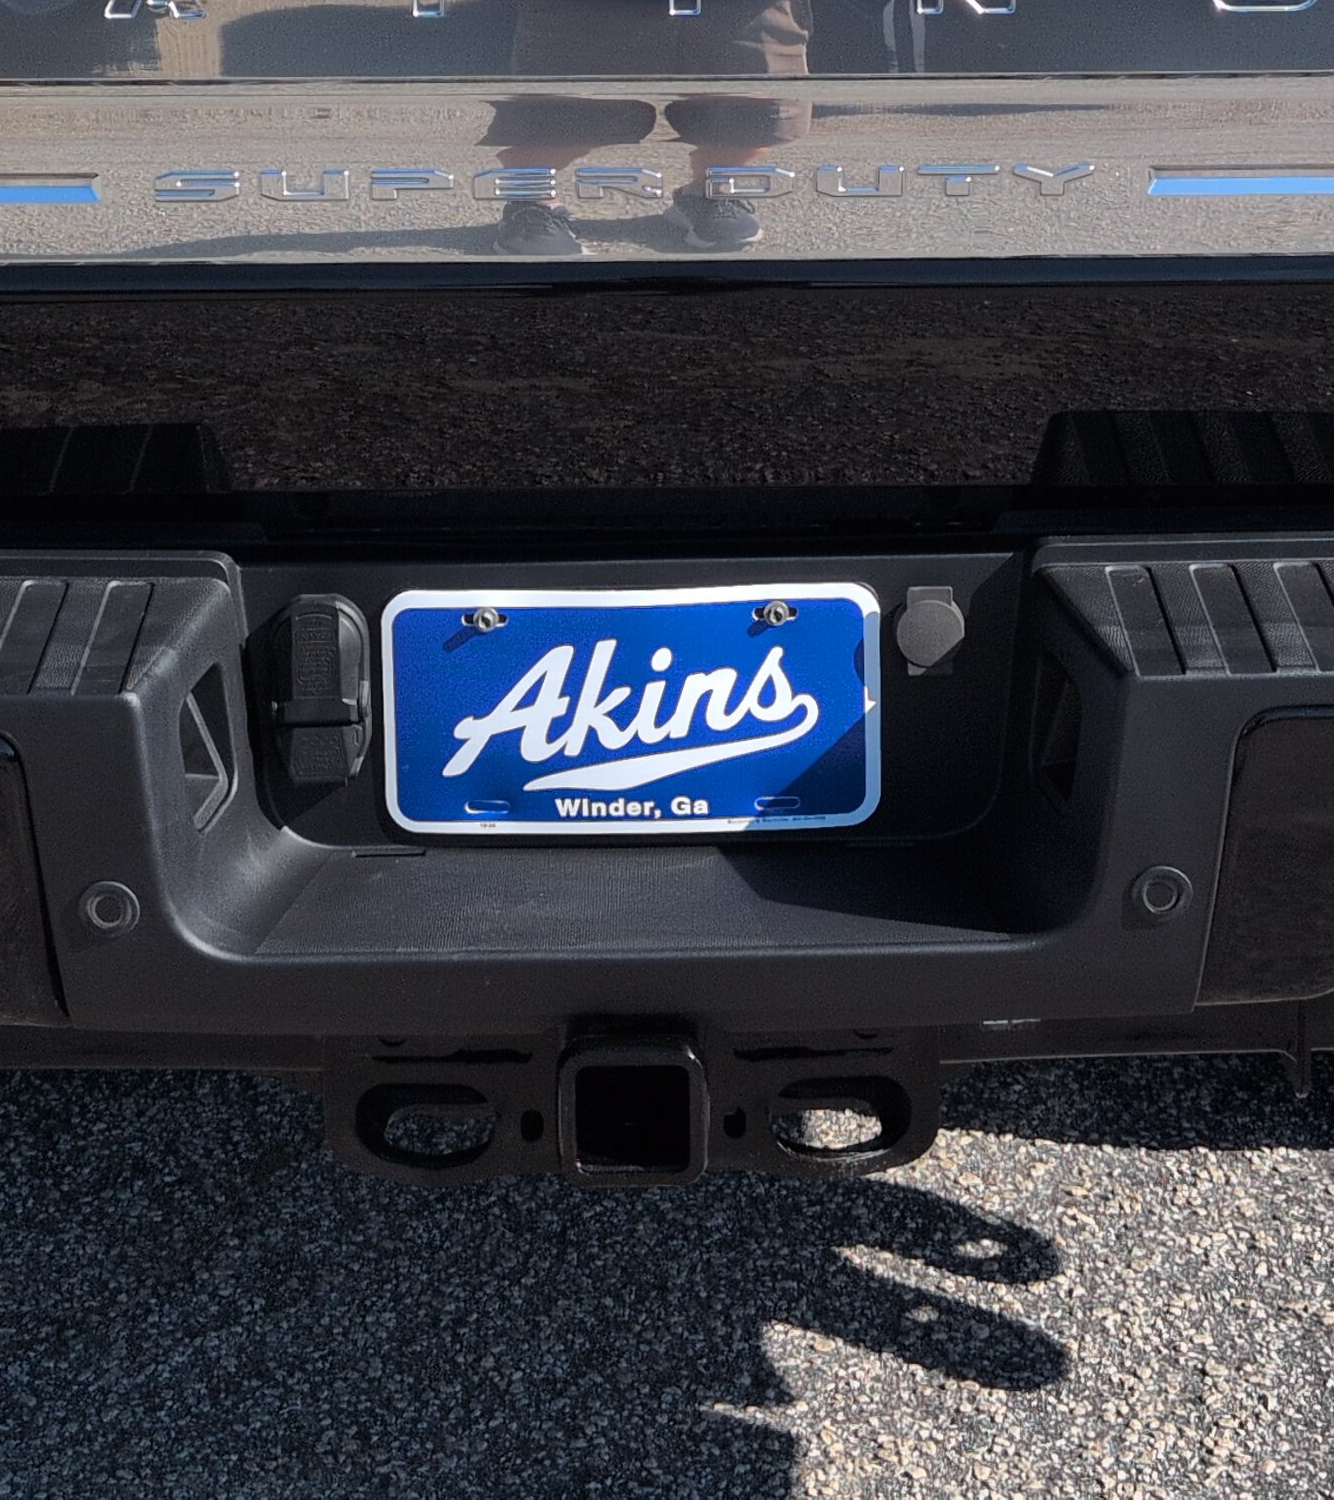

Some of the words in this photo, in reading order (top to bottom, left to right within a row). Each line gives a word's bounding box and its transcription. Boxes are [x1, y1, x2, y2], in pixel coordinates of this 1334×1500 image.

[154, 167, 664, 202] SUPER
[705, 164, 1094, 200] DUTY
[441, 638, 820, 792] Akins
[554, 797, 662, 819] Winder,
[670, 795, 710, 816] Ga
